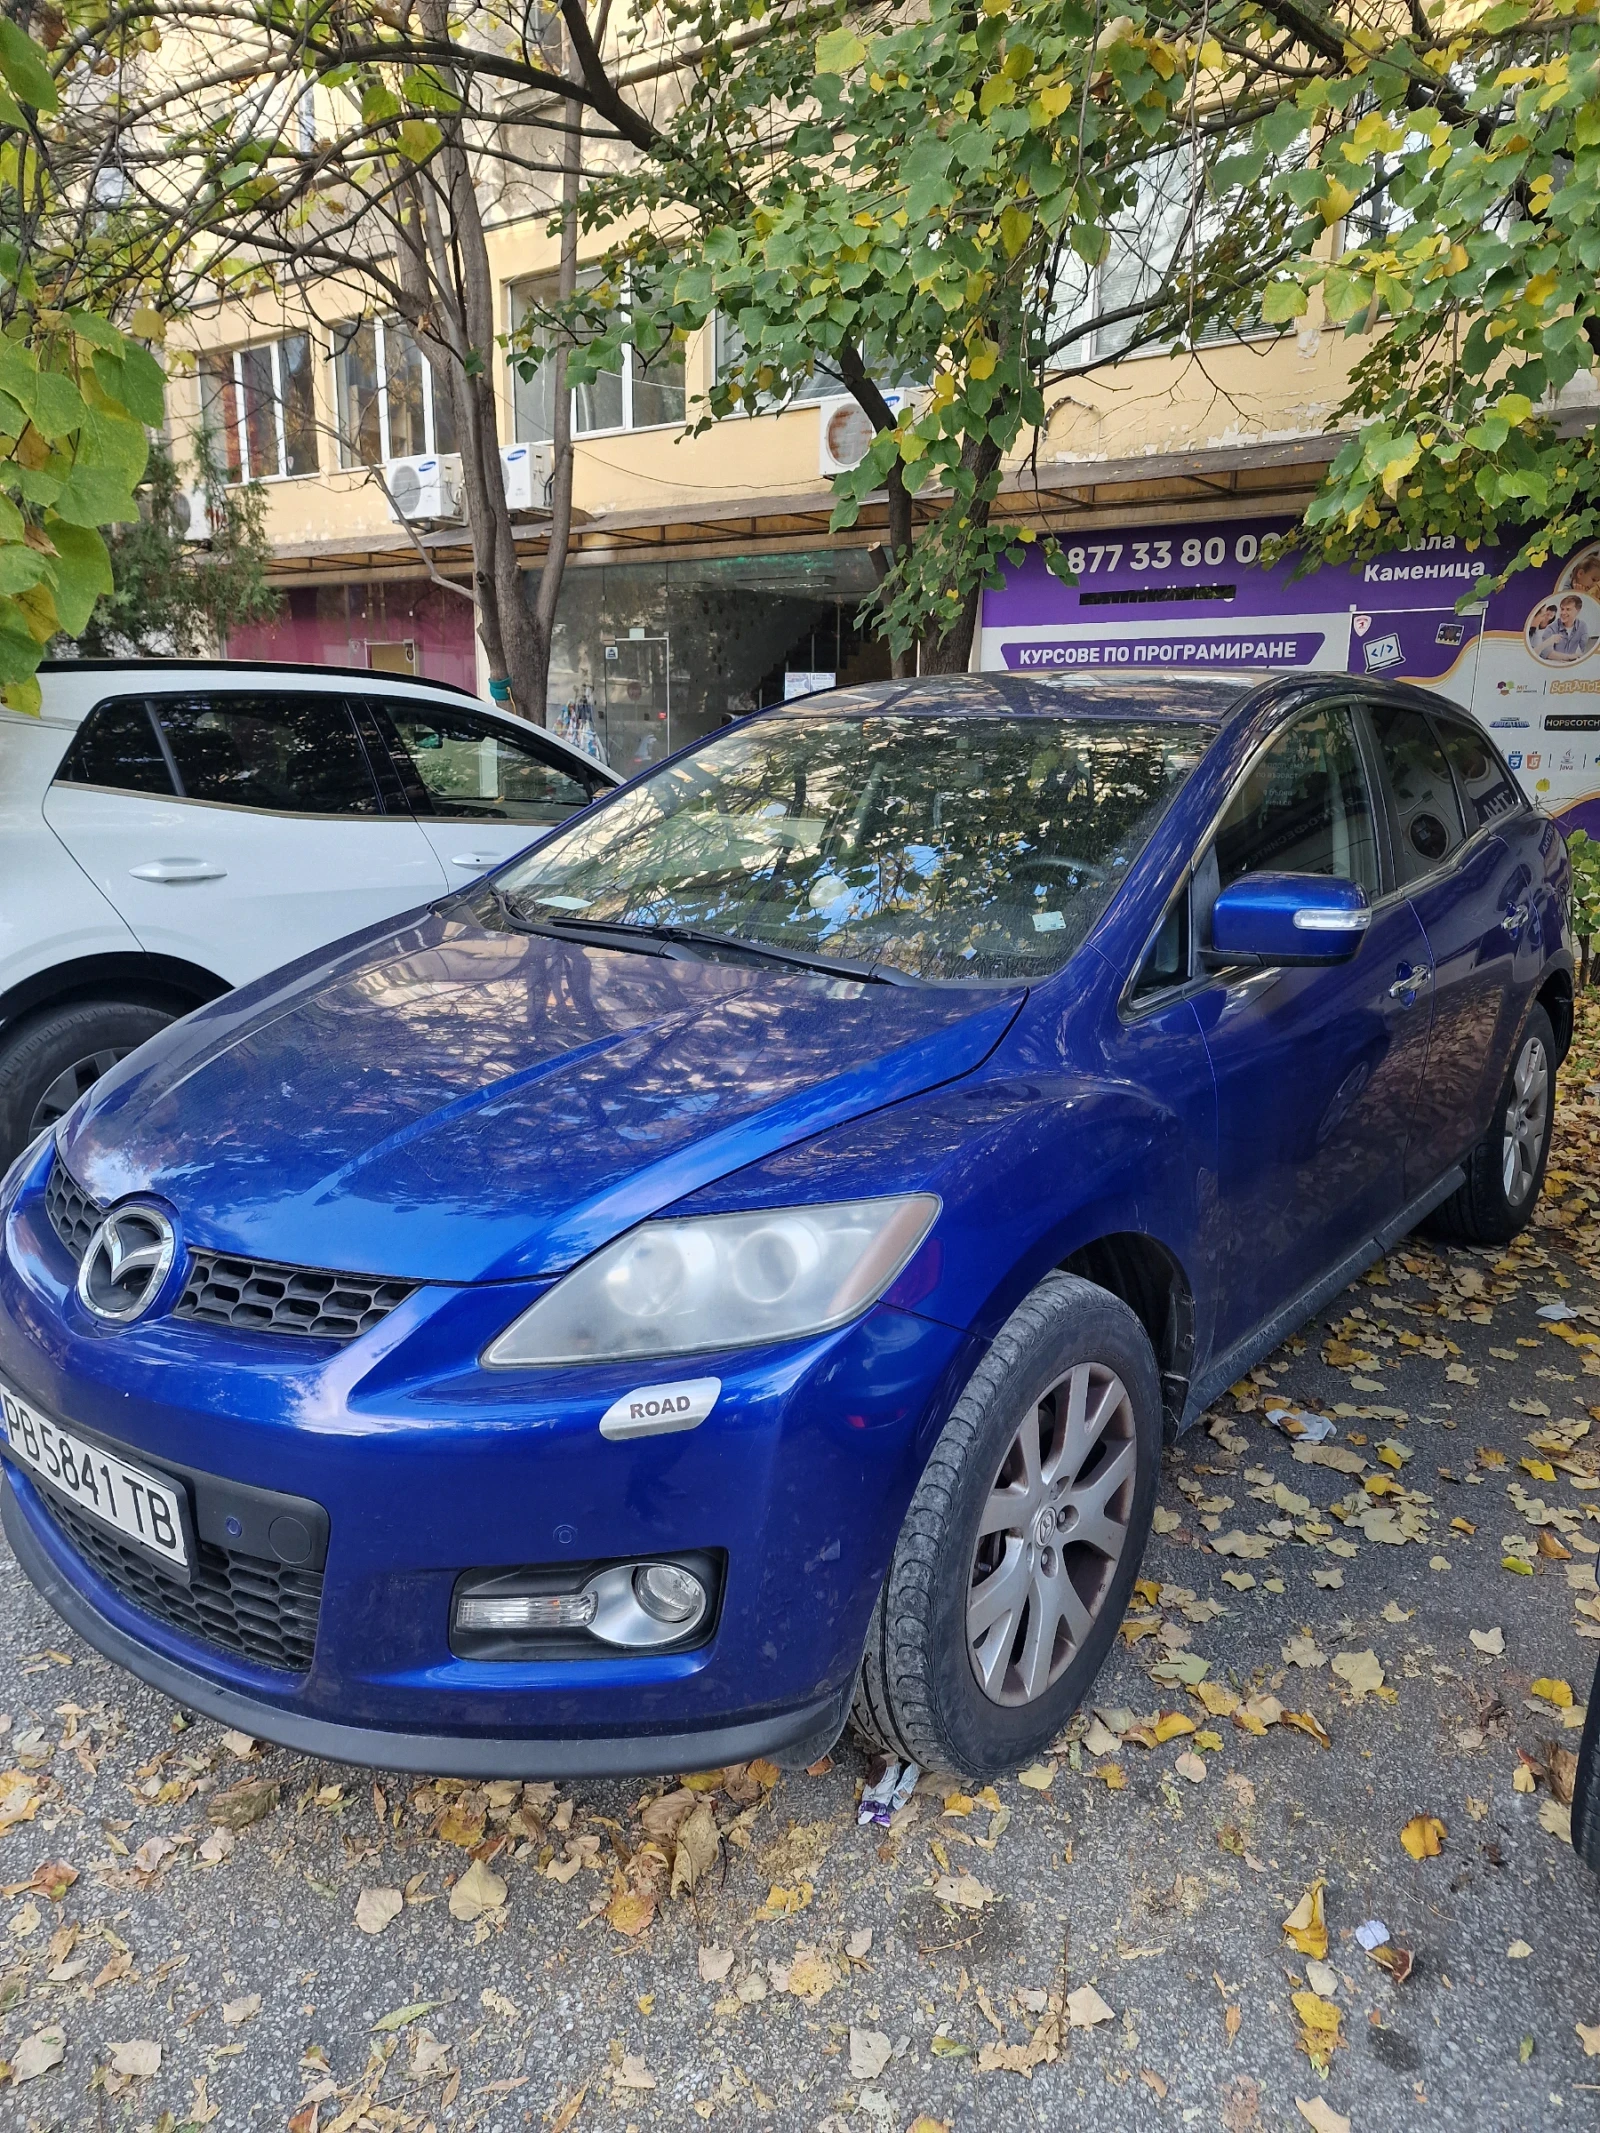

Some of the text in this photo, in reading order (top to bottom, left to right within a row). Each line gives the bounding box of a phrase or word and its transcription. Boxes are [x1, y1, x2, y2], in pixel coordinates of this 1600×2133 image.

[1046, 545, 1123, 576] 877
[1129, 541, 1172, 571] 33
[1180, 536, 1226, 567] 80
[1364, 562, 1485, 582] Каменица
[1019, 641, 1297, 665] КУРСОВЕ ПО ПРОГРАМИРАНЕ
[1560, 763, 1574, 771] Java
[629, 1395, 691, 1419] ROAD
